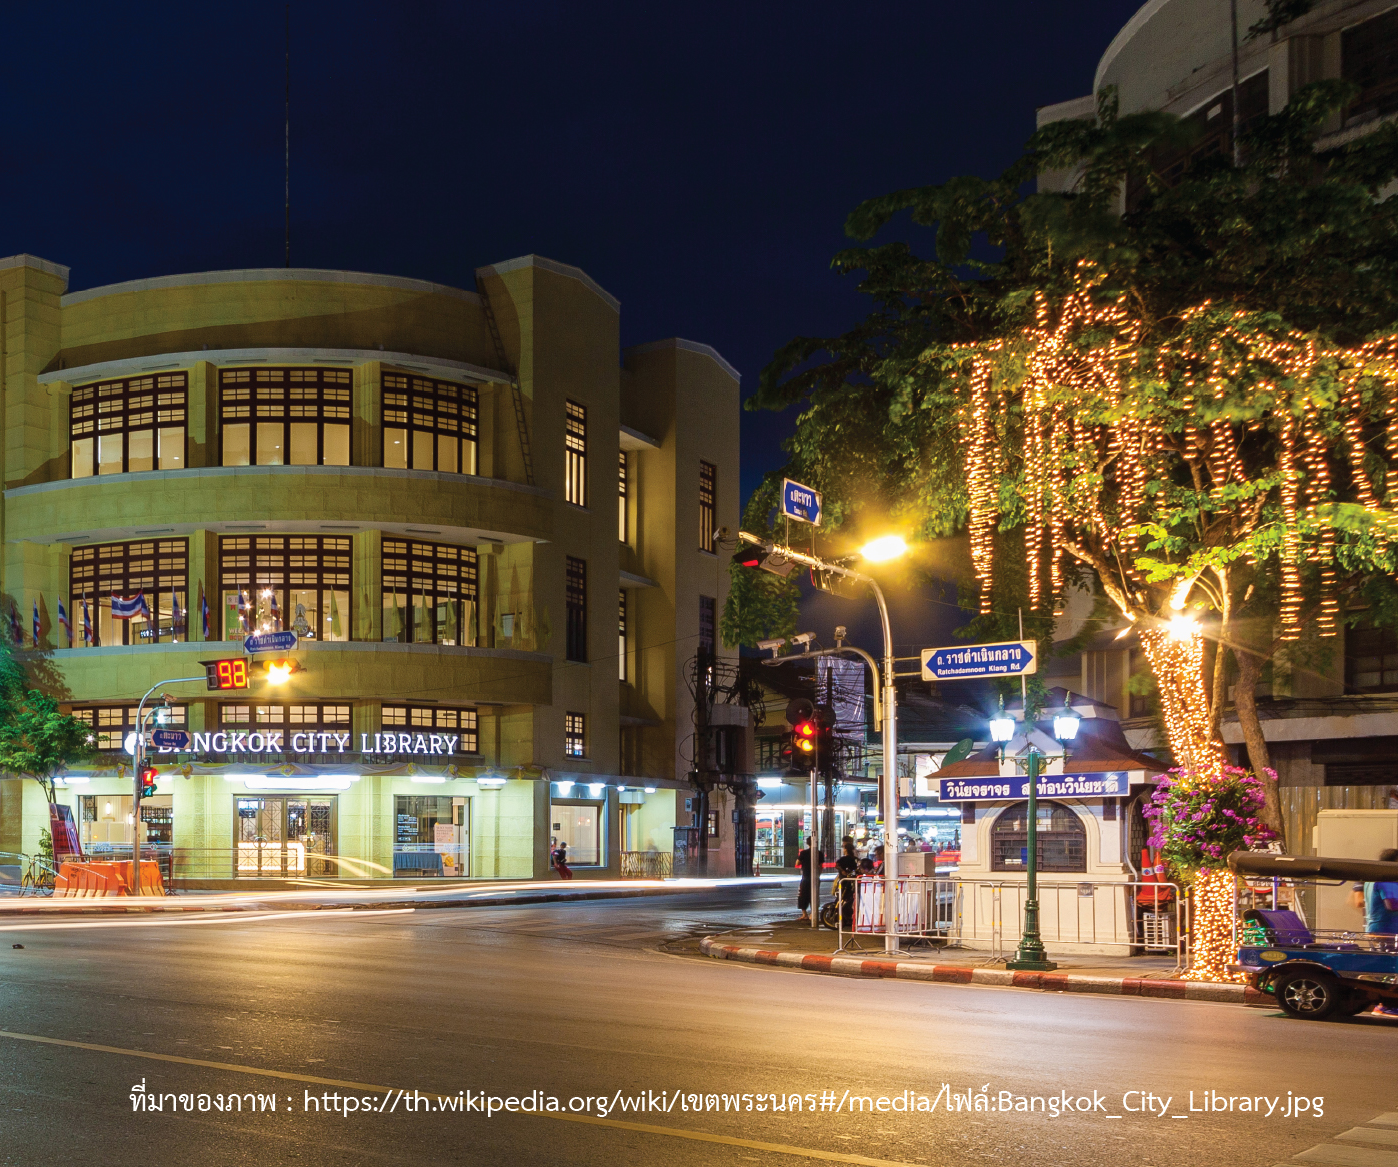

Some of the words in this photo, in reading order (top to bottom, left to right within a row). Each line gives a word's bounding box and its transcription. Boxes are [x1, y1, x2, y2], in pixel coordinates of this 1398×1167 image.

[946, 648, 1021, 665] ราชดำเนินกลาง
[219, 660, 246, 688] 98
[937, 667, 986, 676] Ratchadamnoen
[988, 664, 1008, 673] Klang
[158, 732, 282, 753] NGKOK
[292, 732, 350, 753] CITY
[361, 733, 459, 755] LIBRARY
[946, 781, 1010, 798] วินัยจราจร
[1021, 775, 1119, 796] สท้อนวินัยชาติ
